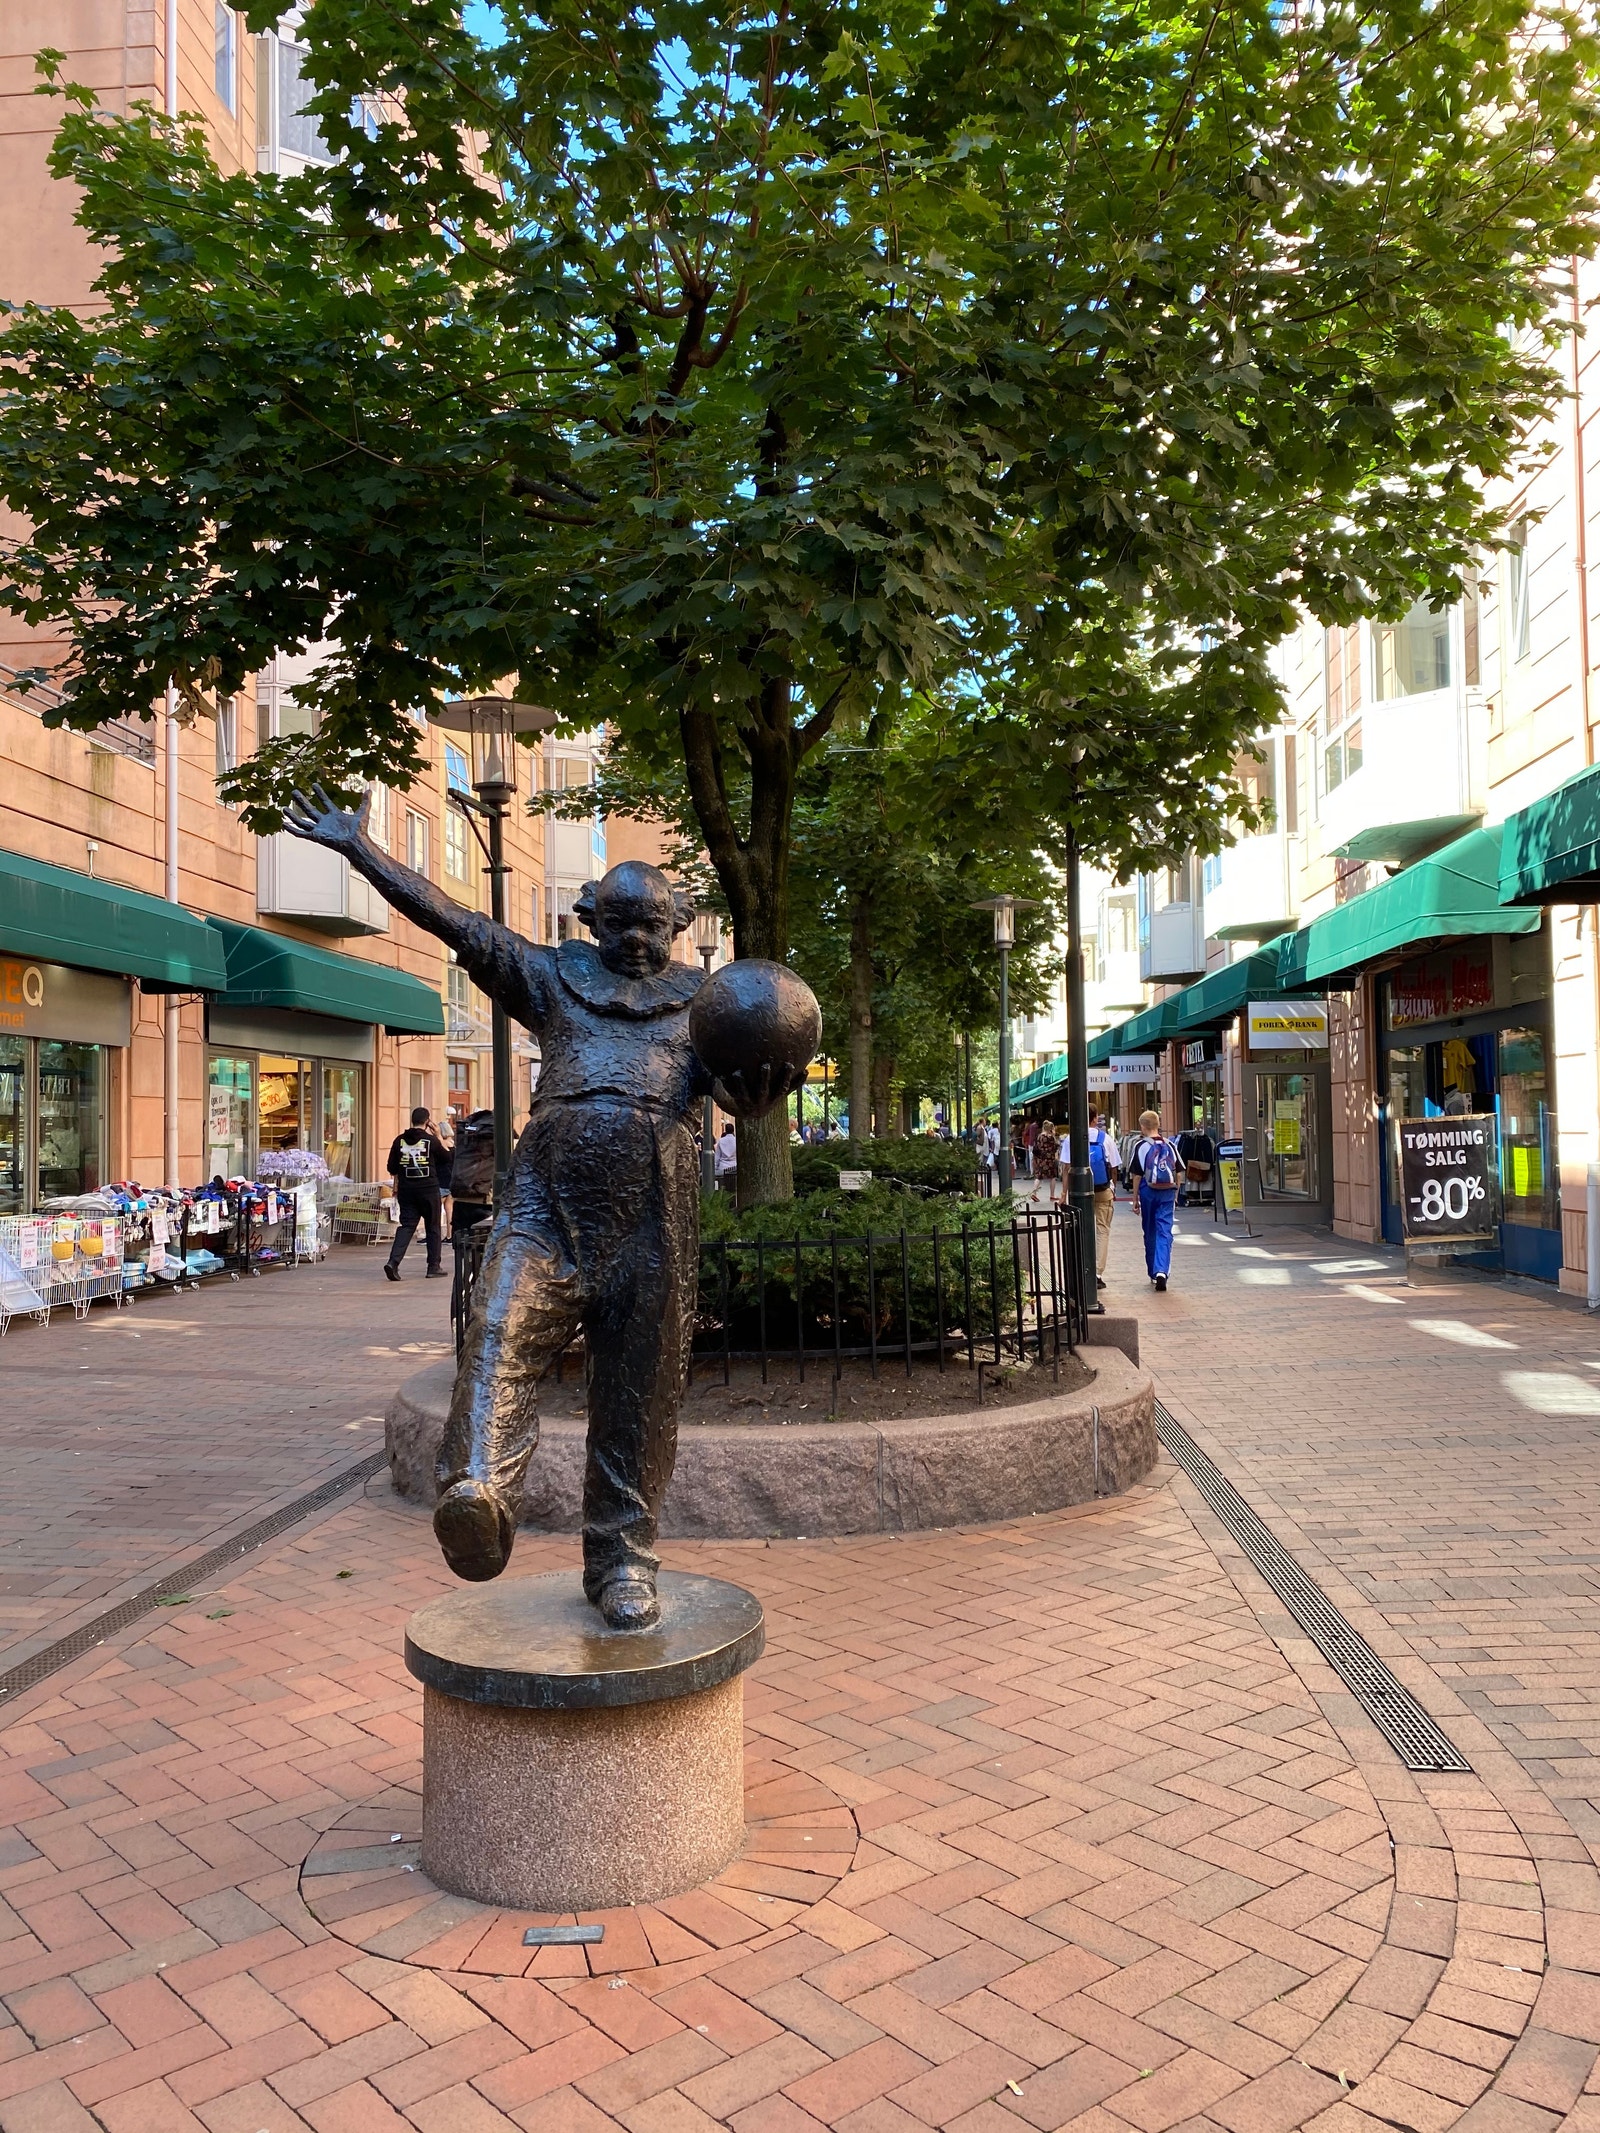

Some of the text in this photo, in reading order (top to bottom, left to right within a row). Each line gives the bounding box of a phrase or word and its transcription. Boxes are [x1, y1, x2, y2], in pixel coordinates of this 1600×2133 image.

[0, 963, 43, 1007] EQ
[1121, 1064, 1154, 1072] FRETEX
[1405, 1130, 1484, 1149] TØMMING
[1425, 1149, 1467, 1167] SALG
[1410, 1176, 1486, 1221] -80%
